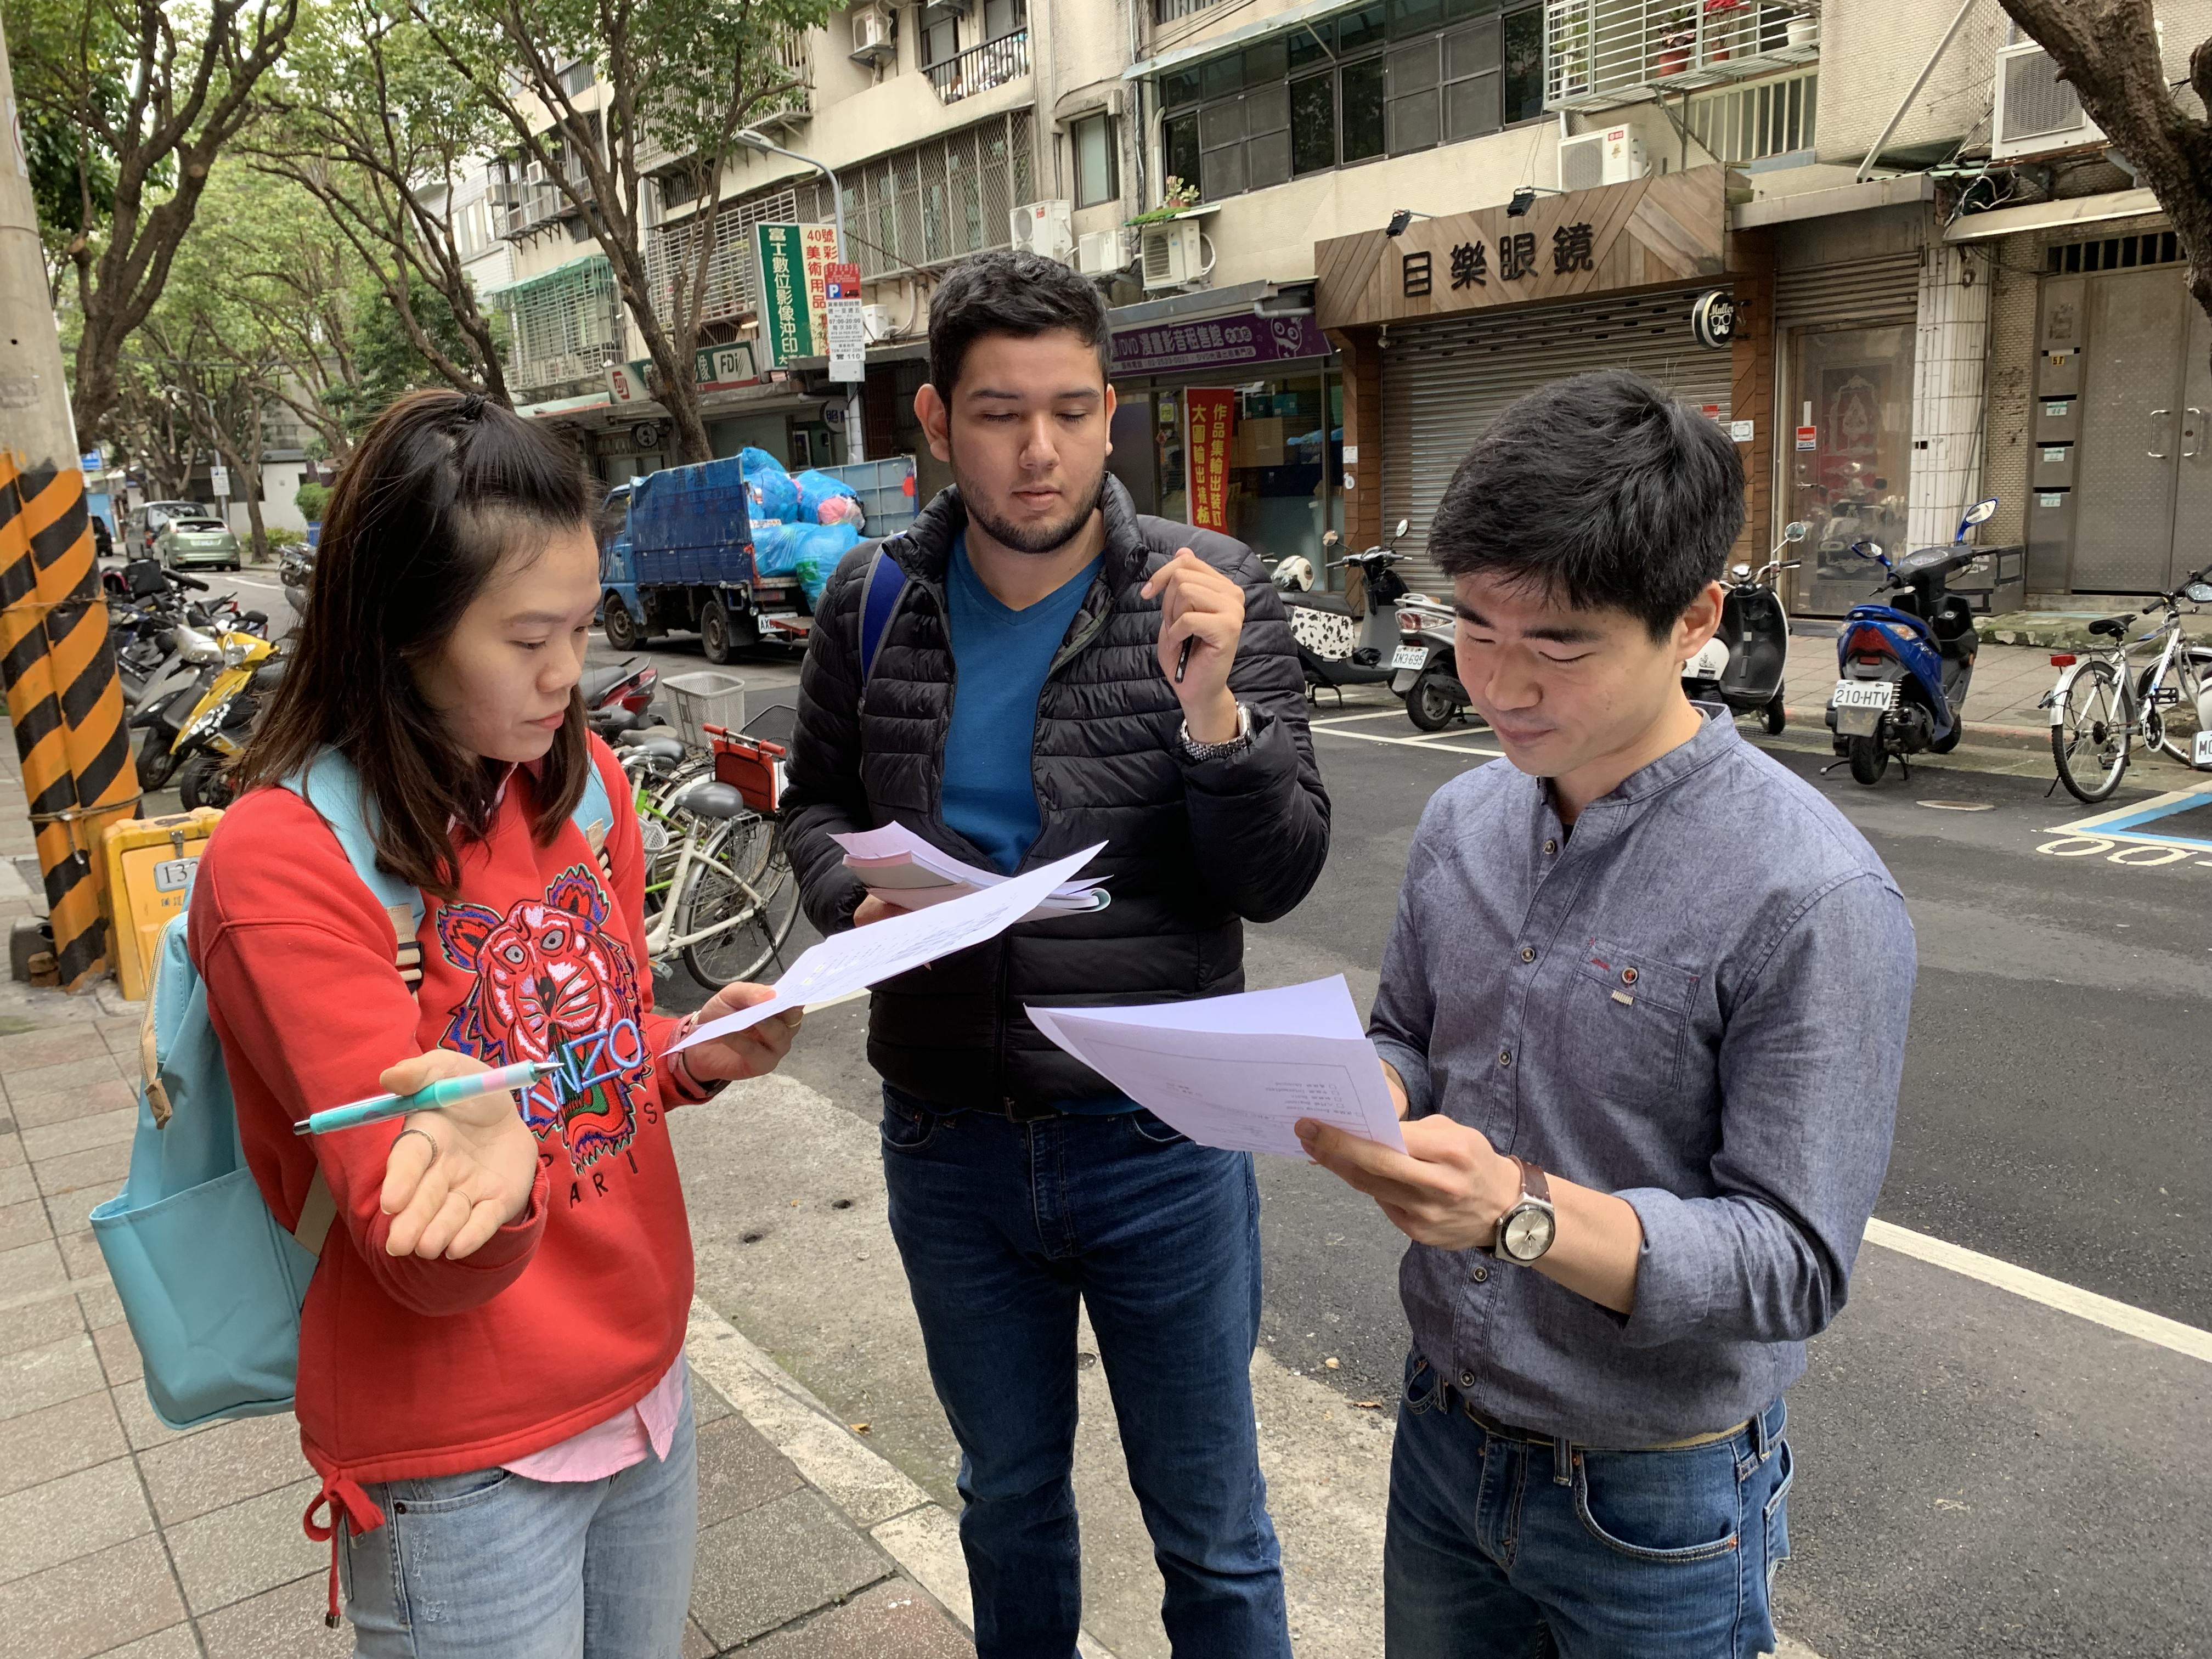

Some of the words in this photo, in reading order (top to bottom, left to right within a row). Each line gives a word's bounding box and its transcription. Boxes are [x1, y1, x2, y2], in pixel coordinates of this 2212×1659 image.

[807, 228, 834, 243] 40號
[806, 245, 826, 309] 美術用品
[1403, 222, 1594, 297] 目樂眼鏡
[768, 228, 798, 353] 富士數位影像沖印
[829, 284, 839, 298] P
[1209, 403, 1227, 527] 作品集輸出裝訂
[1393, 652, 1425, 665] XN3-695
[1835, 690, 1889, 706] 210-HTV
